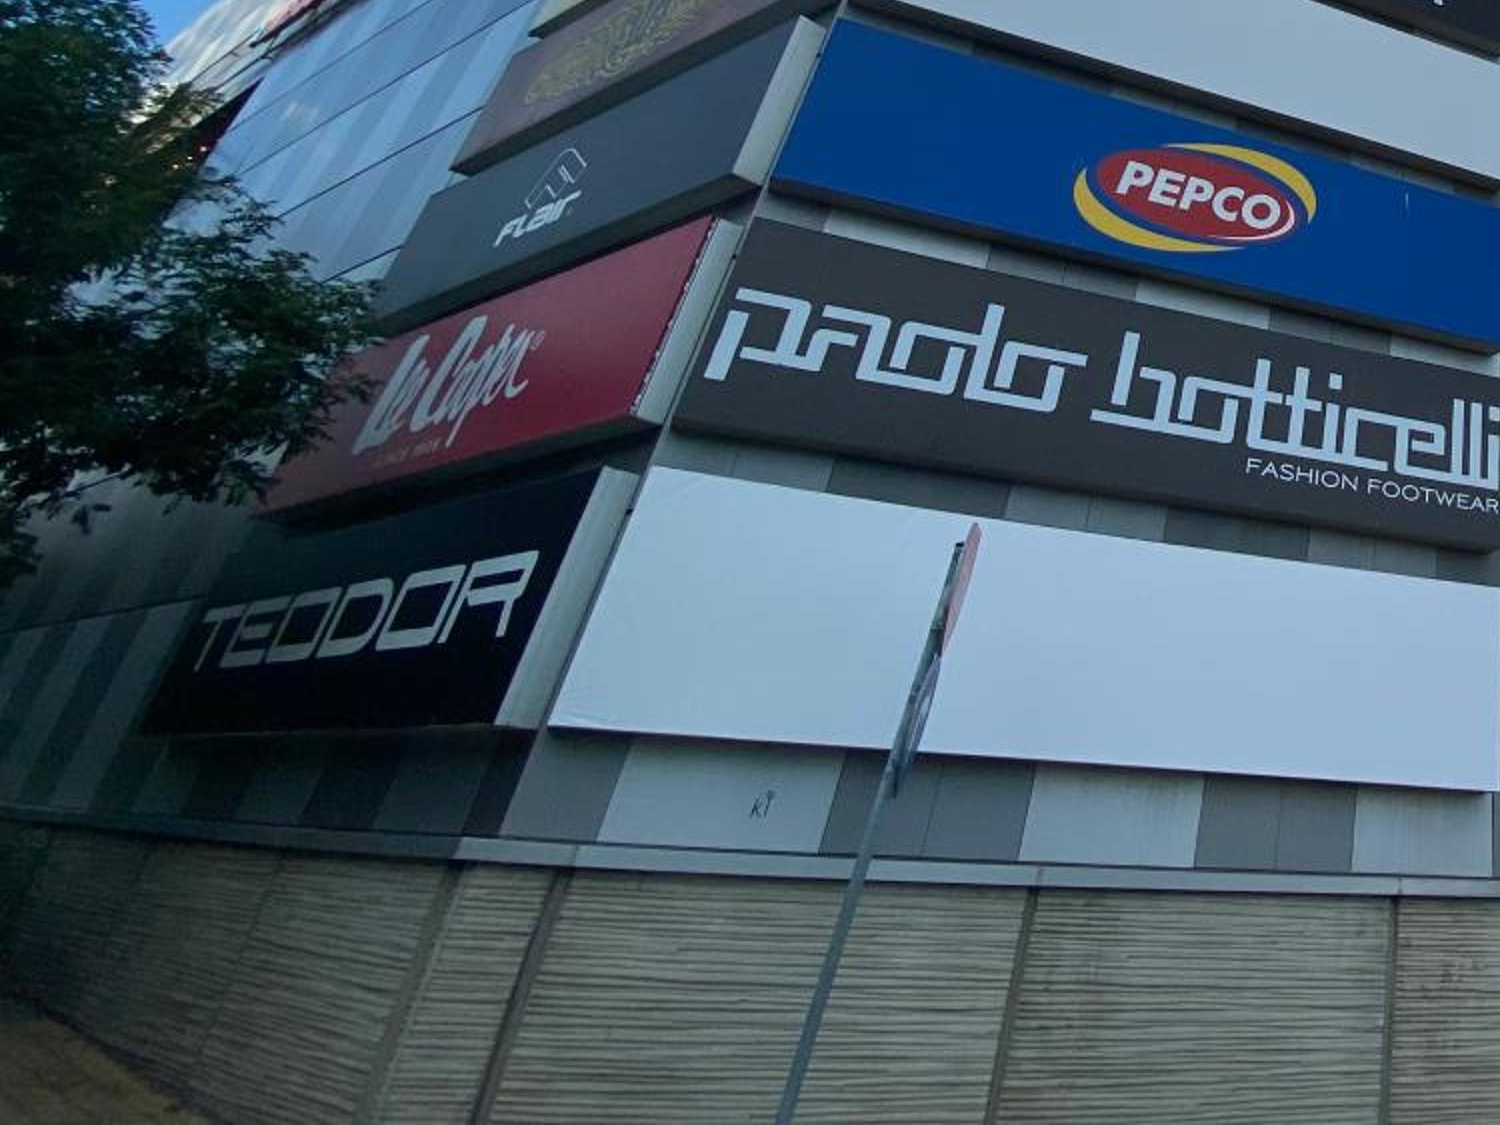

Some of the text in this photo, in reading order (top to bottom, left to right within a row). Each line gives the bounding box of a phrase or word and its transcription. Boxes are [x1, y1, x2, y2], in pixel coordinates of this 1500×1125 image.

[1115, 160, 1281, 230] PEPCO
[703, 286, 1499, 491] paolo botticelli
[1245, 457, 1500, 515] FASHION FOOTWEAR
[193, 550, 540, 672] TEODOR
